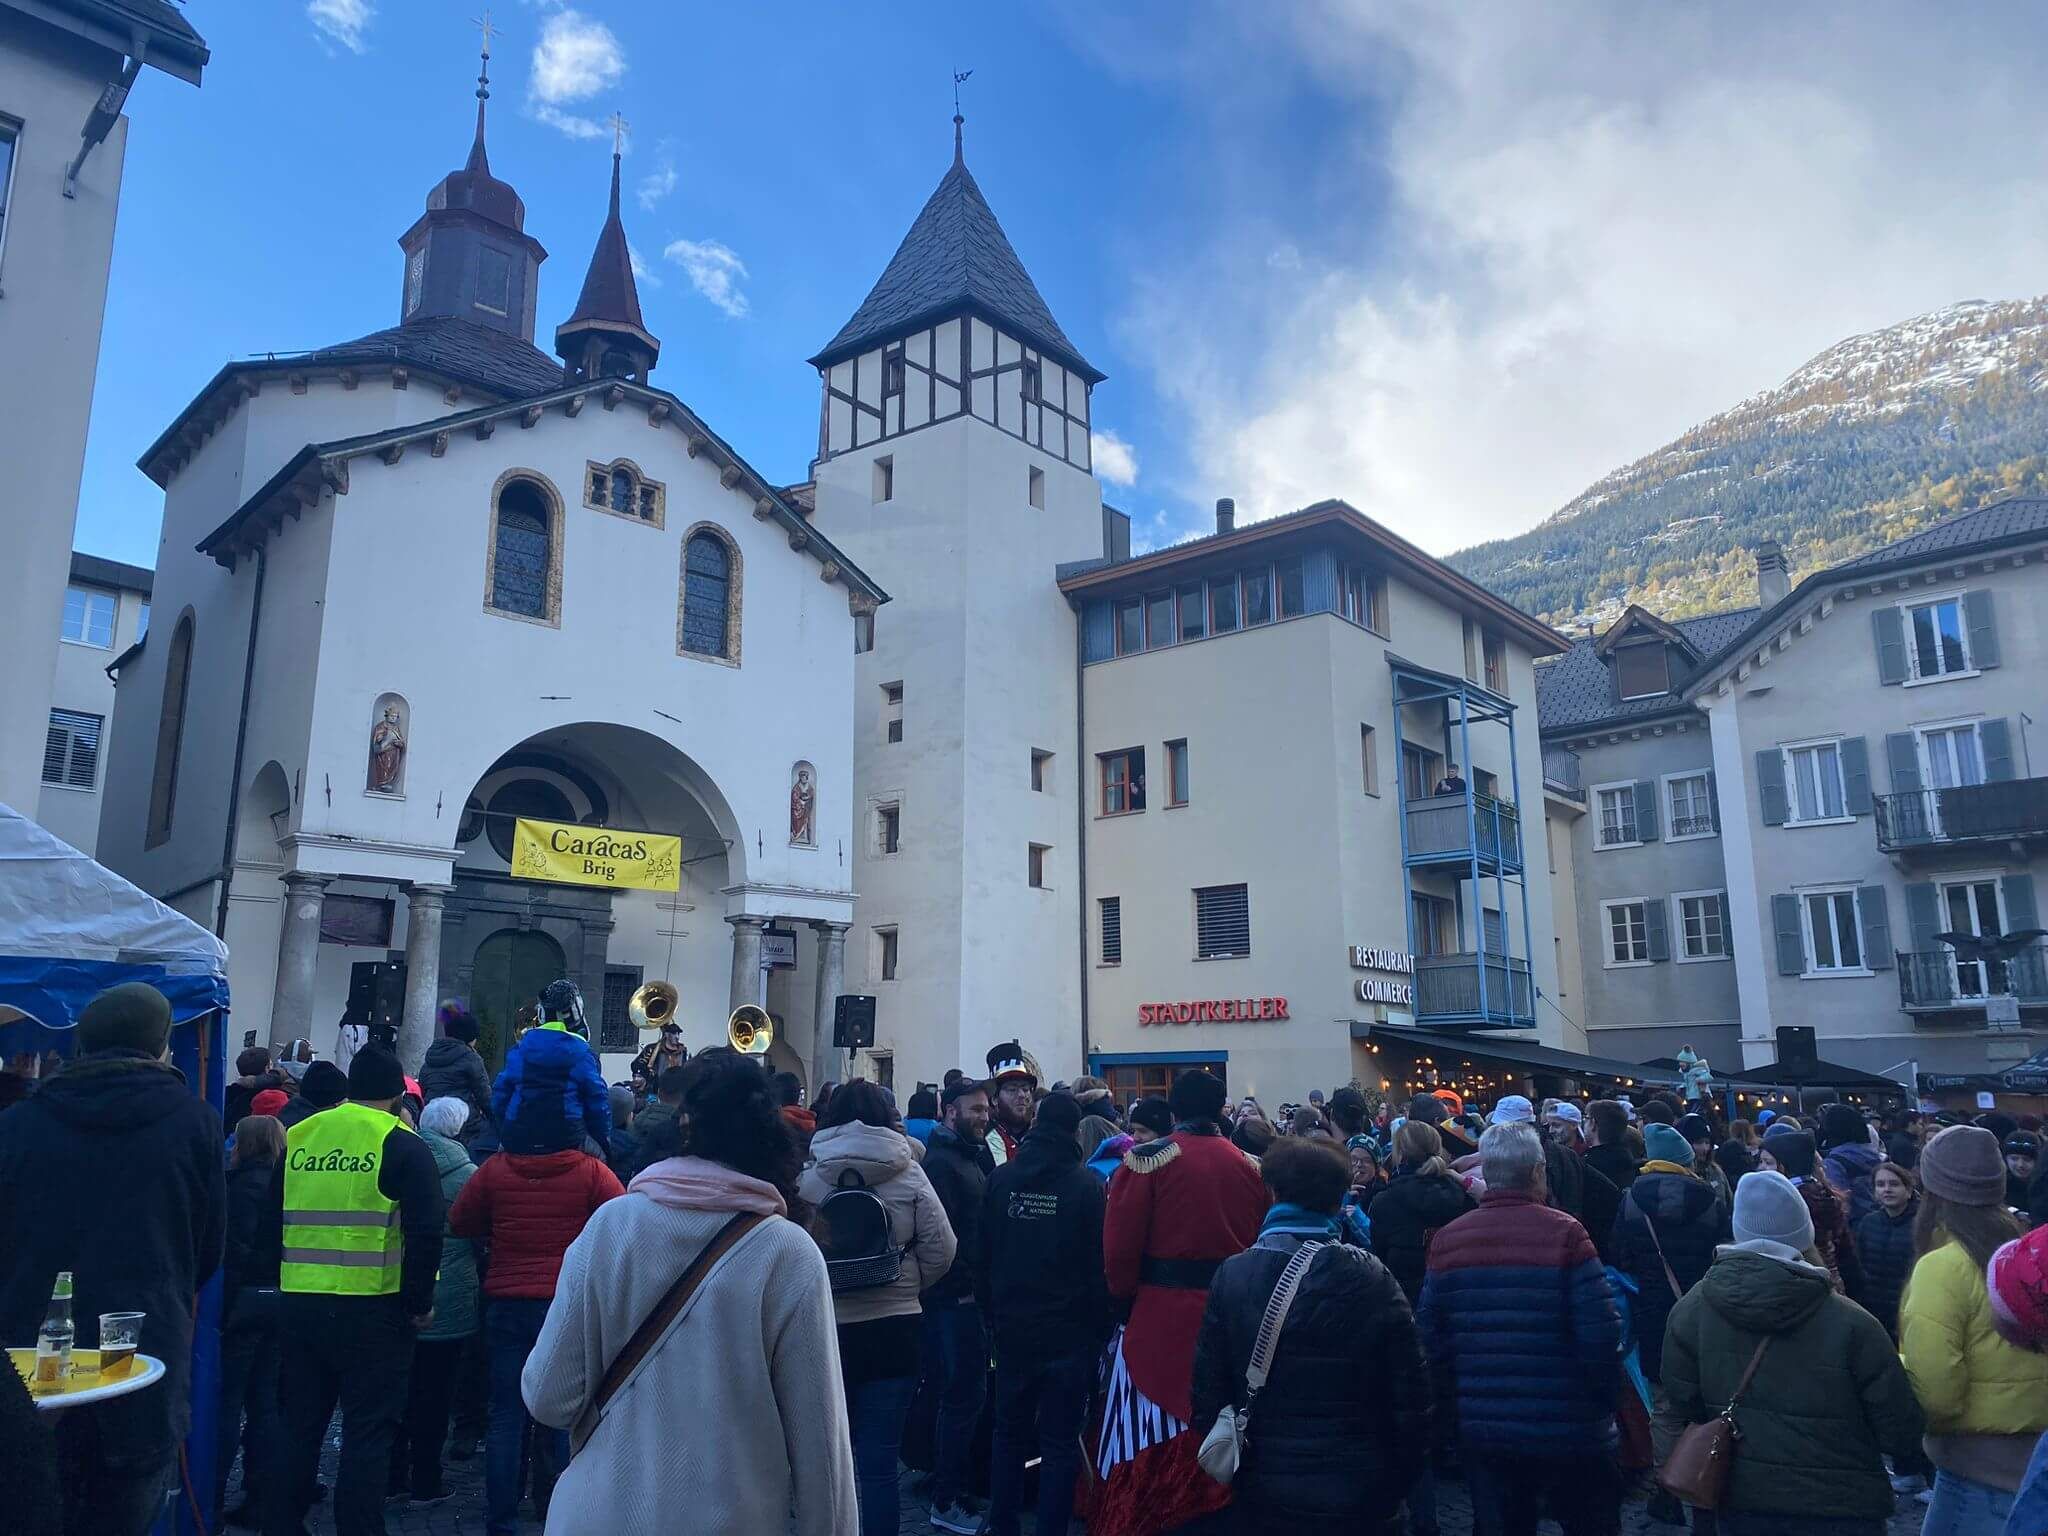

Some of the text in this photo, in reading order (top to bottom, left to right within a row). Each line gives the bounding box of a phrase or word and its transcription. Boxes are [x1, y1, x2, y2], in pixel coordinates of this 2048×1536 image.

[551, 829, 647, 860] Caracas
[582, 860, 616, 880] Brig
[1356, 946, 1414, 973] RESTAURANT
[1361, 980, 1412, 1004] COMMERCE
[1138, 997, 1289, 1025] STADTKELLER
[290, 1147, 376, 1173] Caracas
